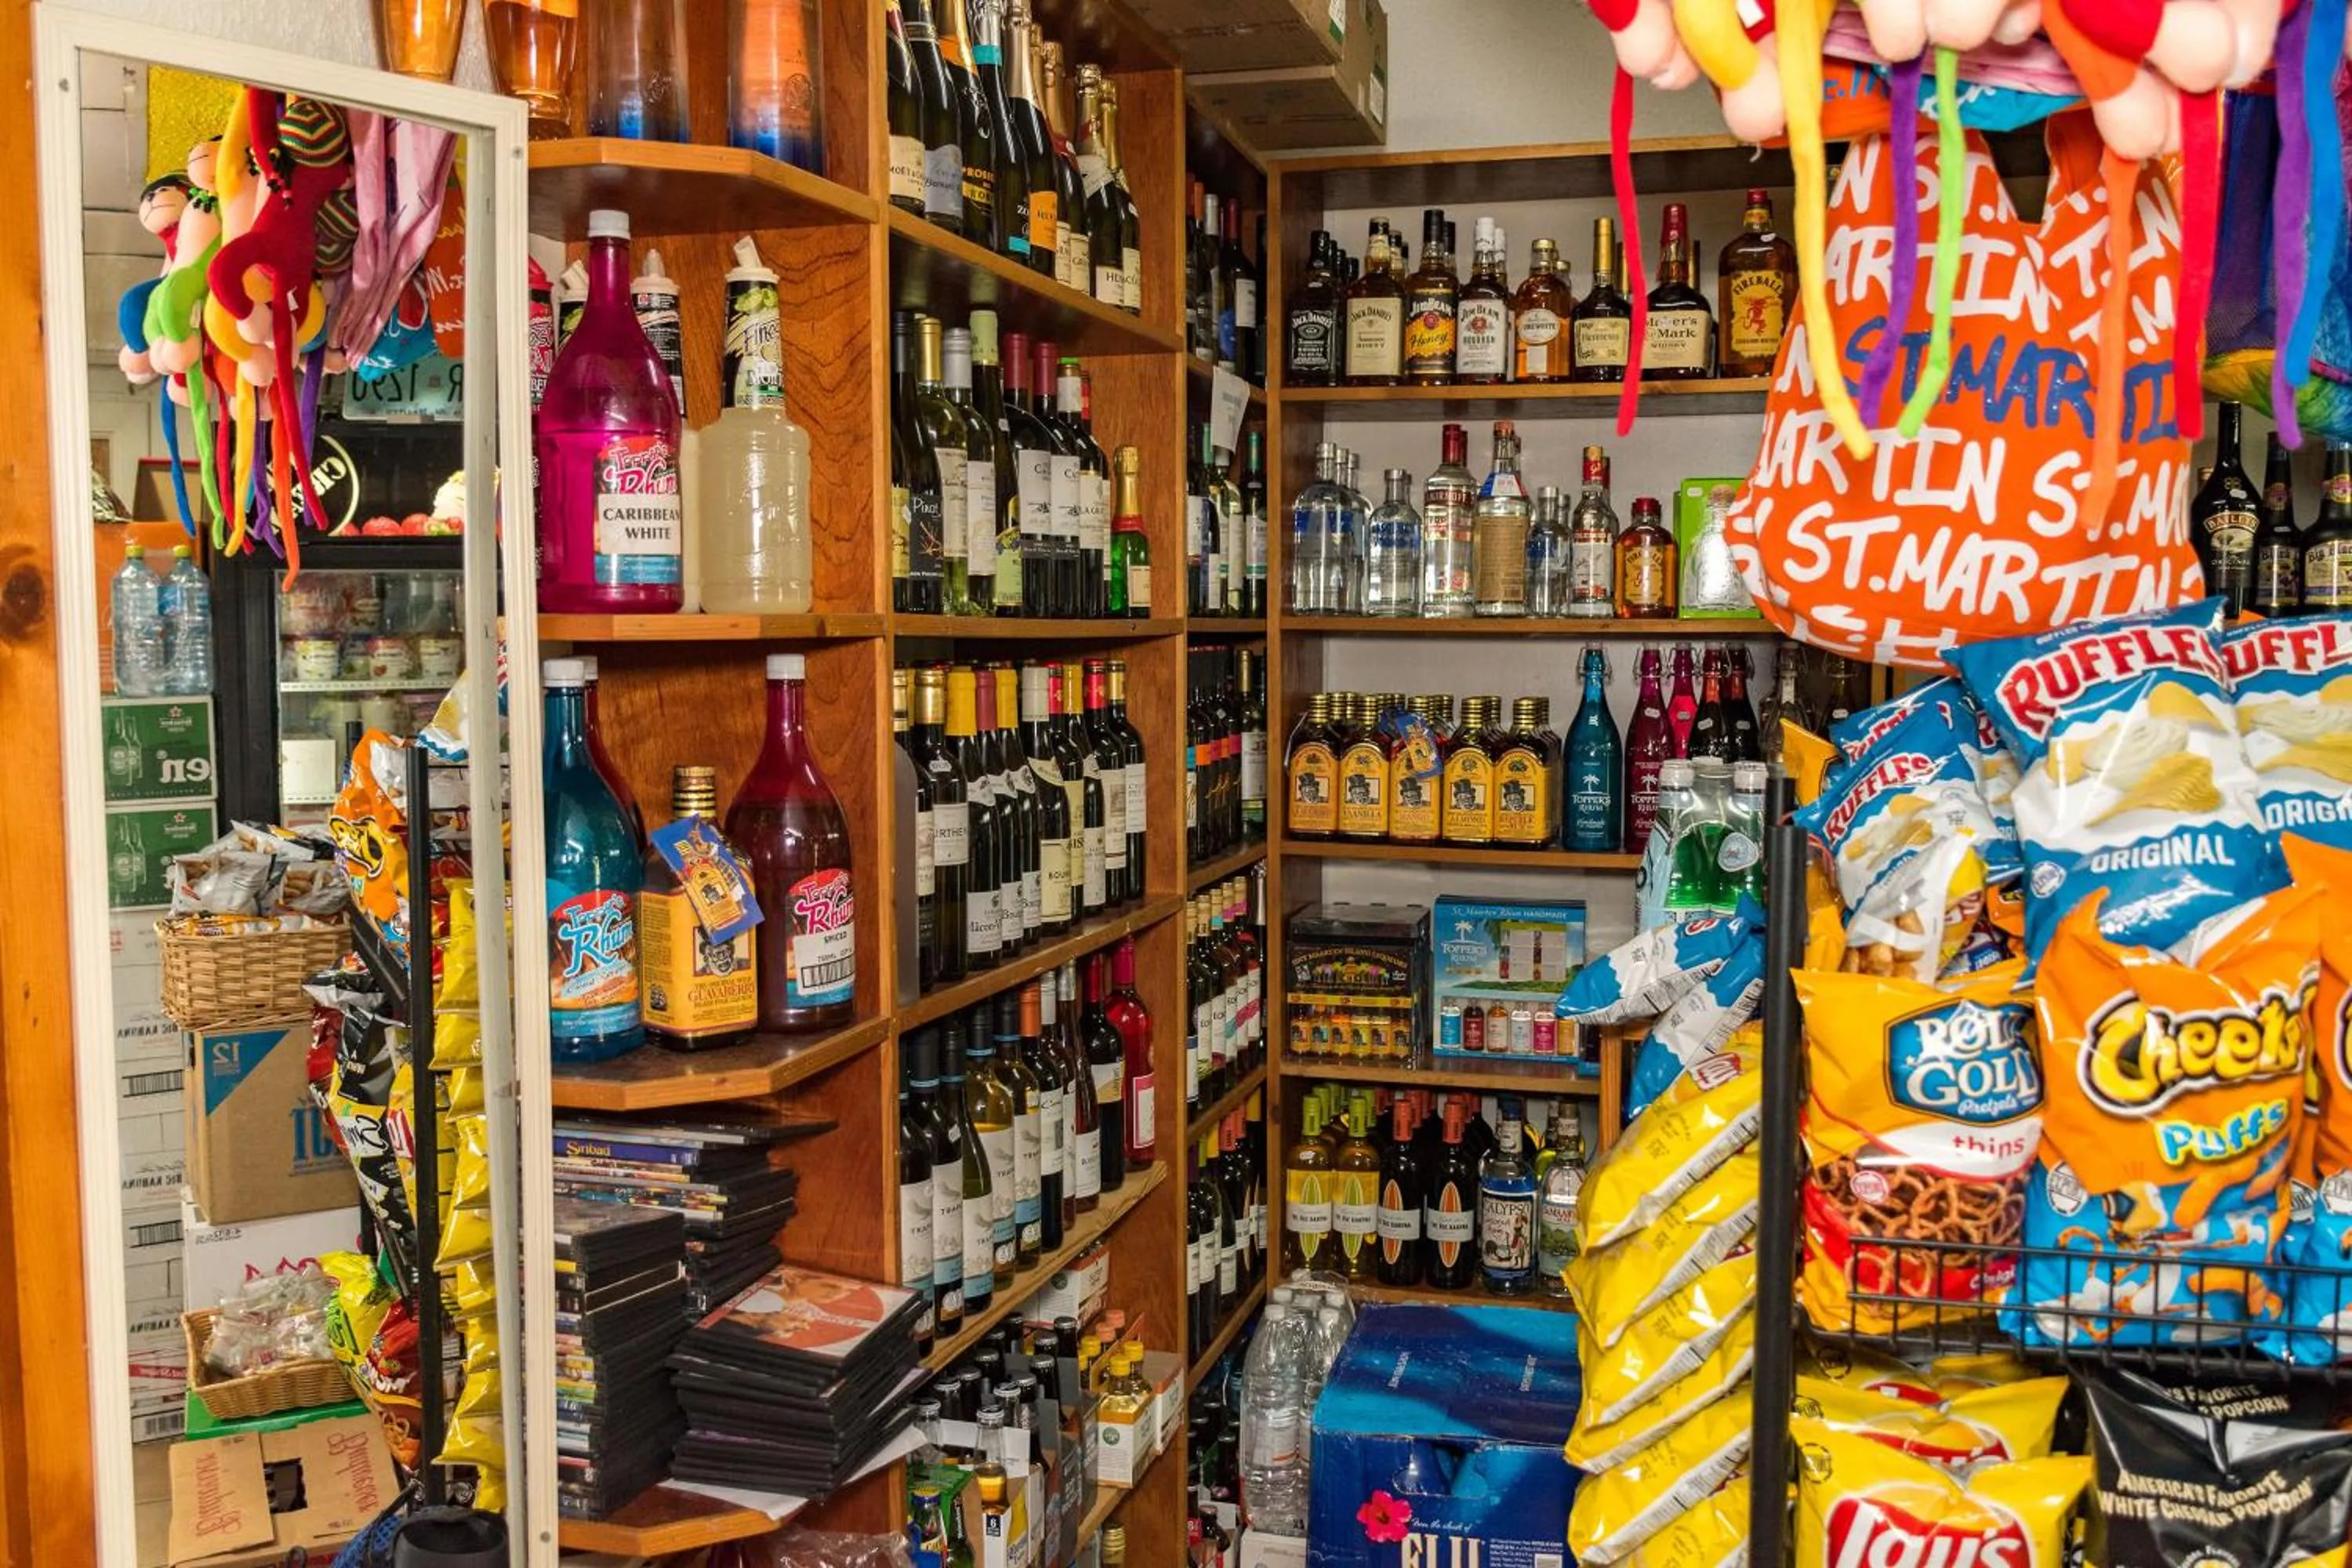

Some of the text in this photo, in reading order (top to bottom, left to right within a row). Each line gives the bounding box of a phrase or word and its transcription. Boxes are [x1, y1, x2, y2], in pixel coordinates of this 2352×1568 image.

[1411, 332, 1449, 346] Honey
[1657, 328, 1697, 339] Mark
[625, 527, 672, 539] WHITE
[2091, 833, 2235, 873] ORIGINAL
[2160, 1100, 2290, 1165] Puffs
[1953, 1135, 2026, 1159] thins
[2211, 1396, 2288, 1421] POPCORN
[2100, 1491, 2158, 1519] WHITE
[2233, 1477, 2313, 1522] POPCORN
